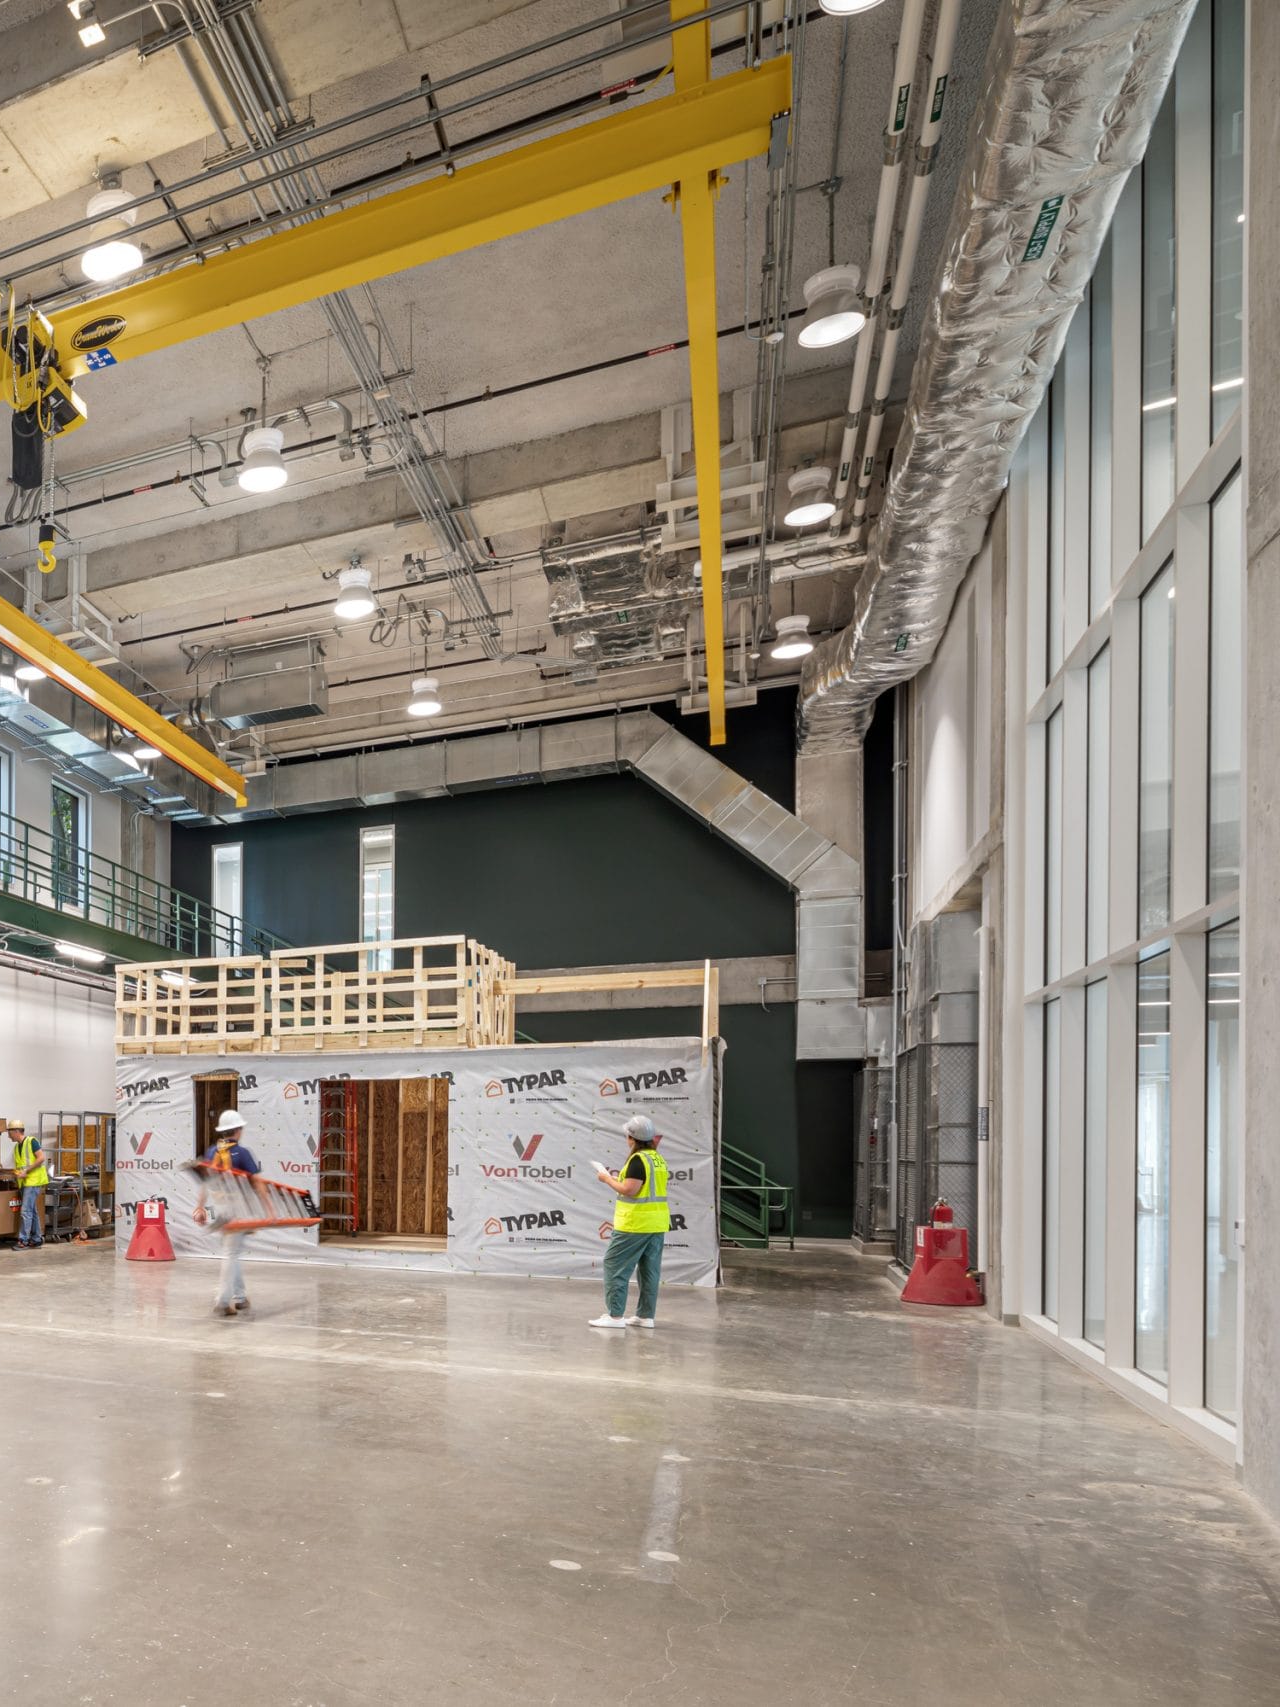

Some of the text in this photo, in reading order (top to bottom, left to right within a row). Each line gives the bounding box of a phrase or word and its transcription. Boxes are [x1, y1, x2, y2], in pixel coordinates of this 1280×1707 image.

[1032, 212, 1056, 240] SUPPLY
[122, 1076, 170, 1098] TYPAR
[501, 1069, 567, 1094] TYPAR
[616, 1067, 688, 1093] TYPAR
[116, 1159, 173, 1170] onTobel
[480, 1164, 572, 1179] VonTobel
[500, 1210, 566, 1232] TYPAR
